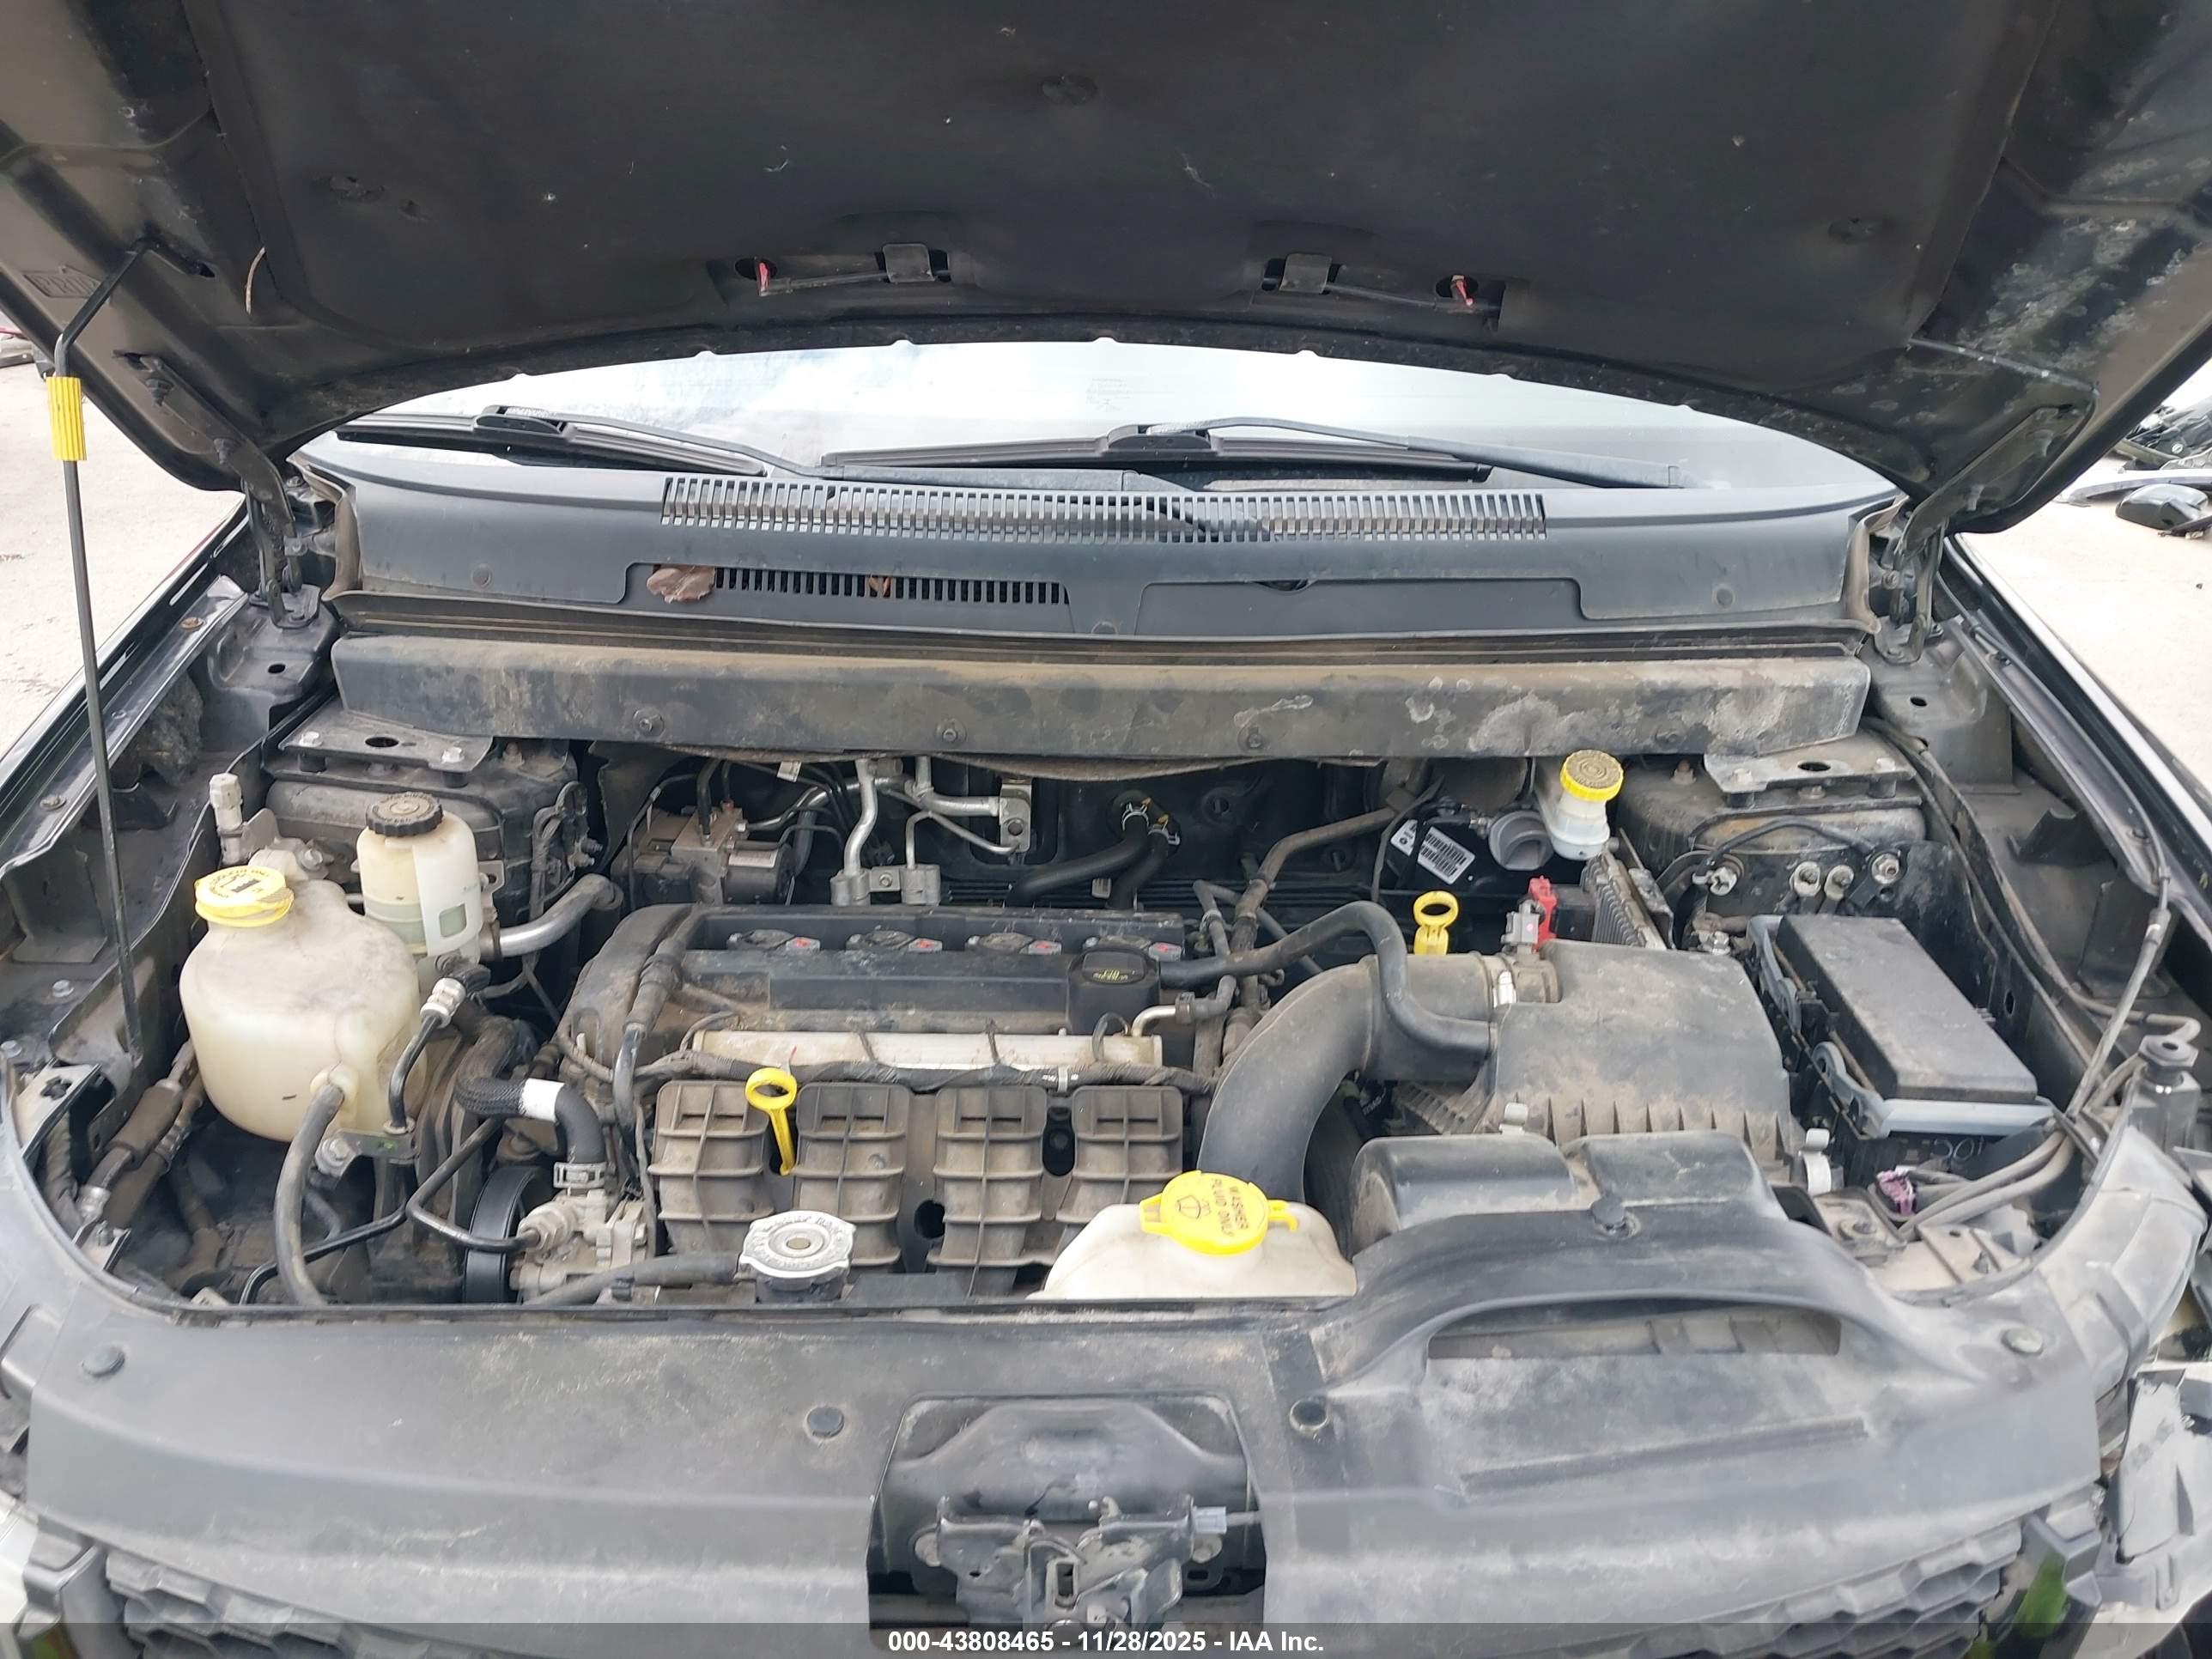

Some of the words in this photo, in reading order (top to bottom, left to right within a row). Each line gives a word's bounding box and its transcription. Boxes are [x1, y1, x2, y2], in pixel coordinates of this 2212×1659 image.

[1210, 1177, 1228, 1207] FLUID
[1217, 1209, 1235, 1237] ONLY
[1229, 1186, 1249, 1230] WASHER
